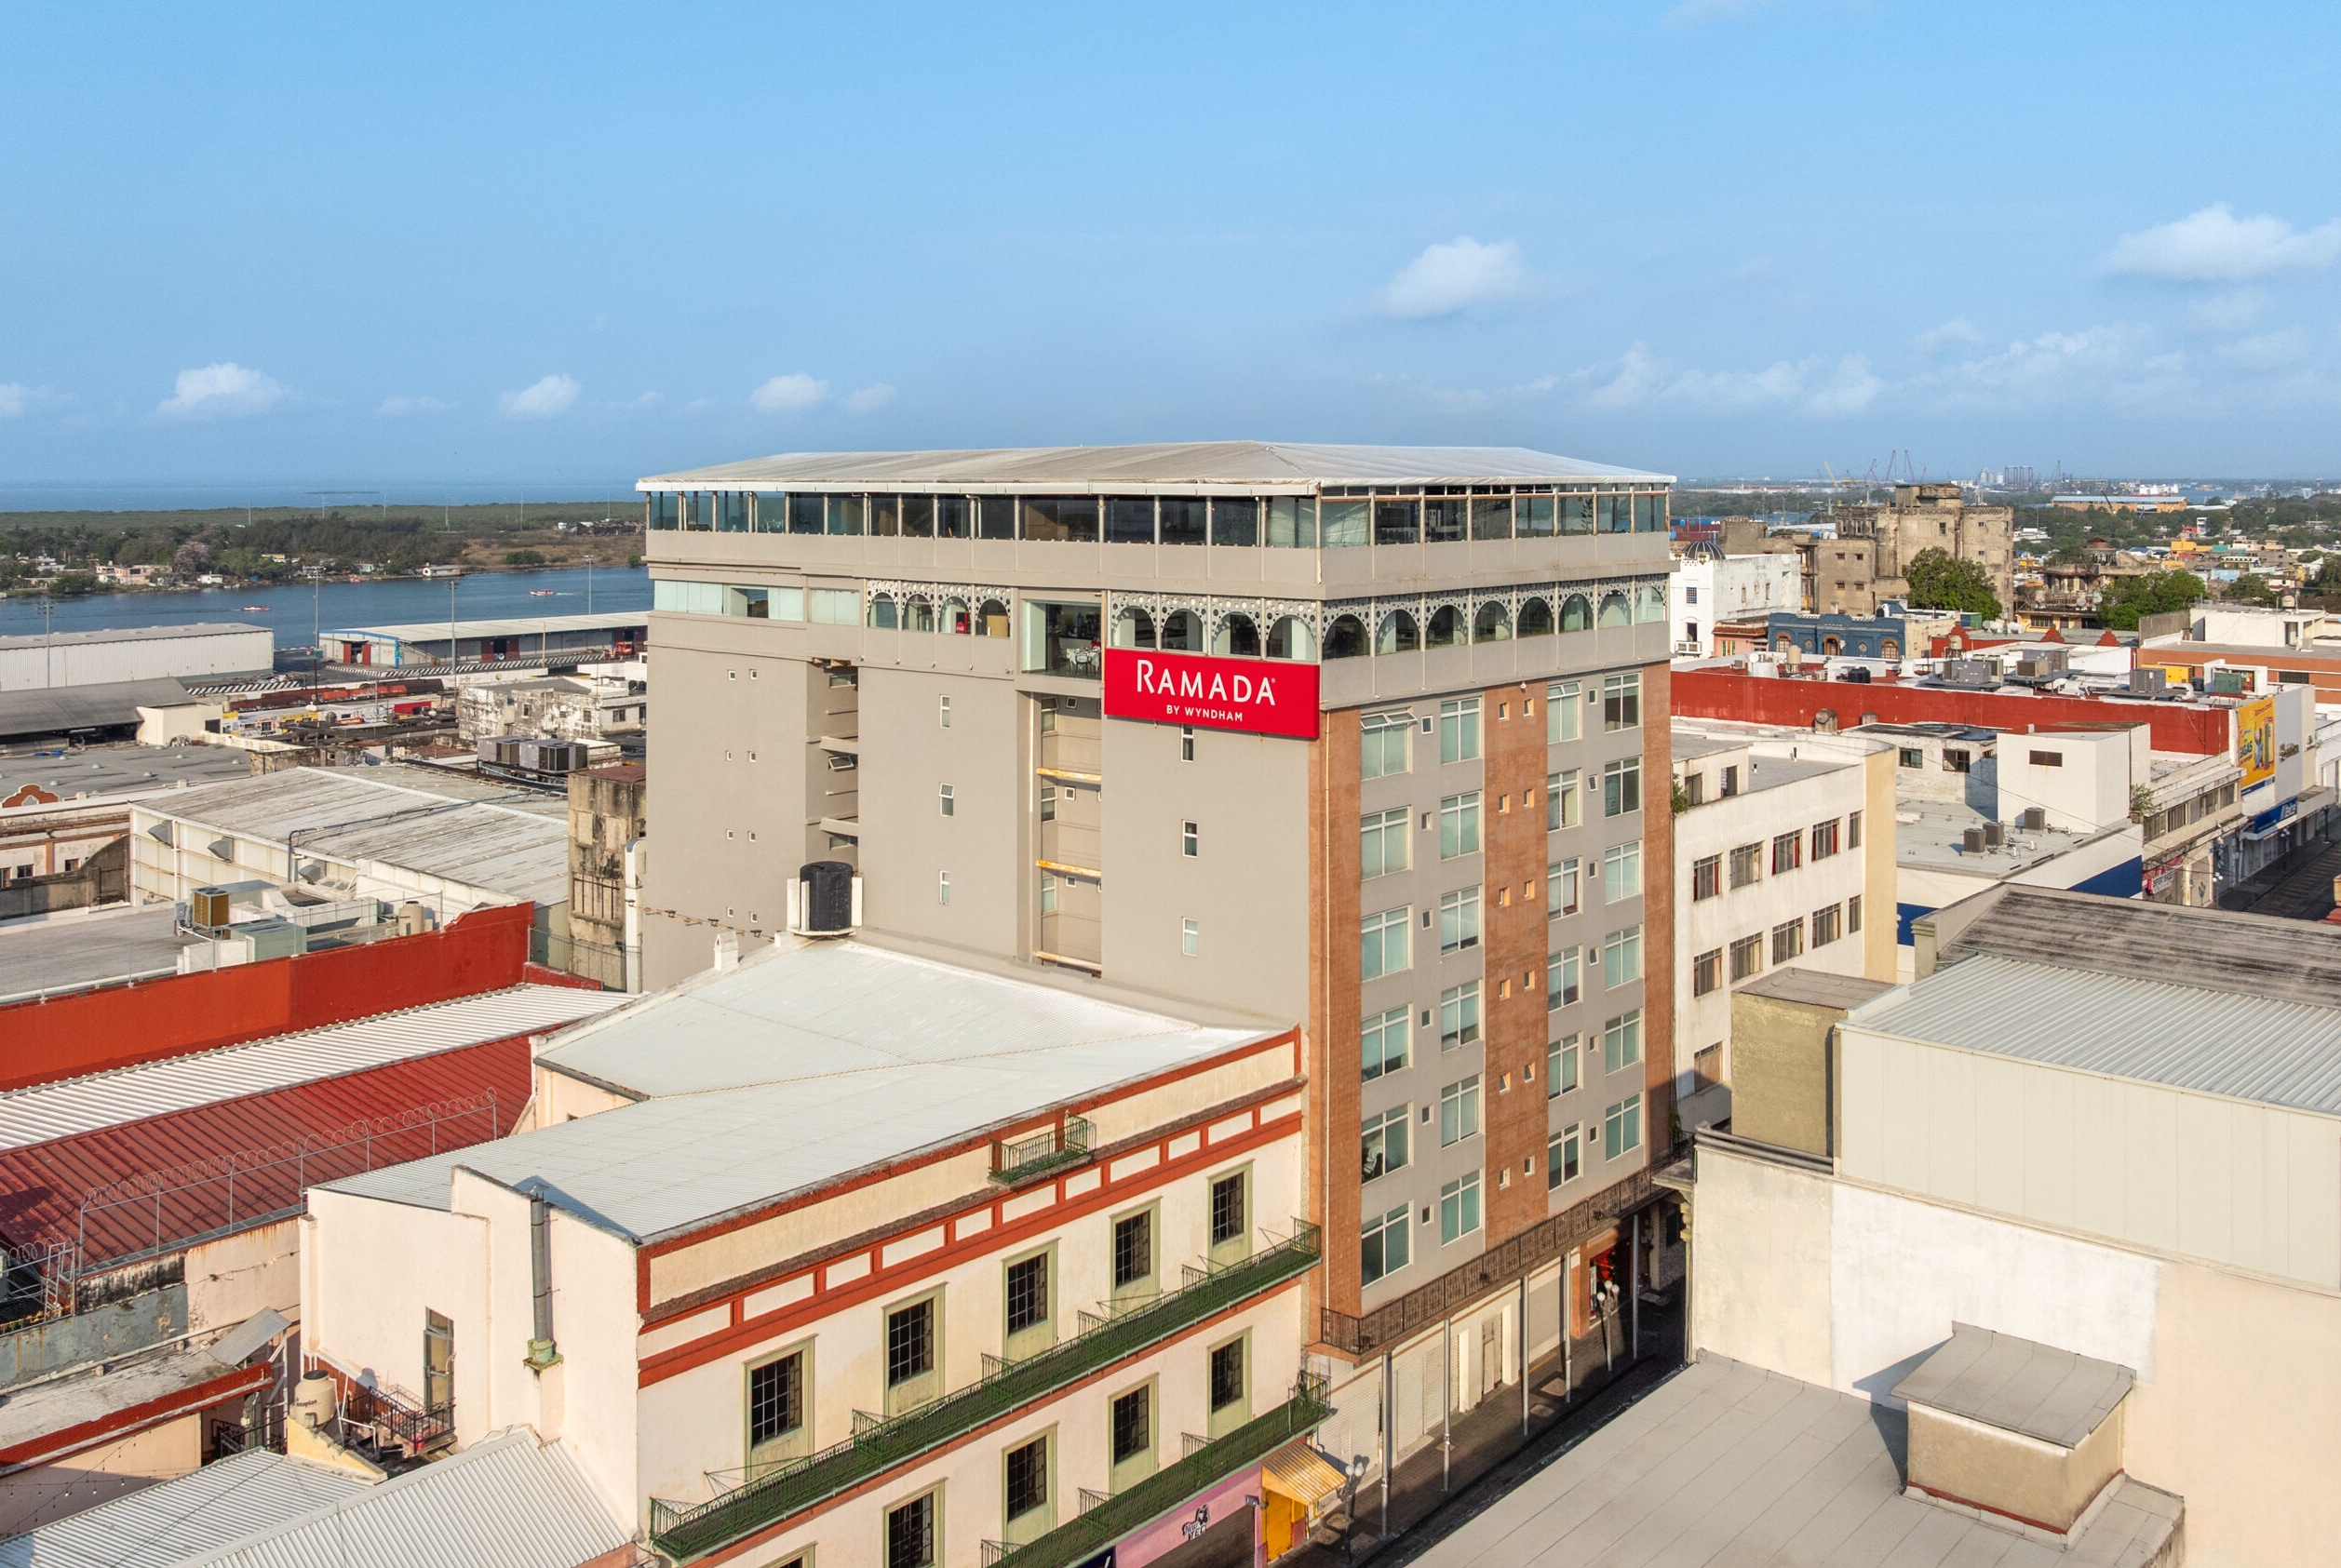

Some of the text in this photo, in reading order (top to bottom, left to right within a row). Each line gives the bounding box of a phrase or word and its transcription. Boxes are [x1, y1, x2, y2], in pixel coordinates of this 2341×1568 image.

[1137, 659, 1276, 706] RAMADA
[1166, 704, 1244, 722] BY WYNDHAM
